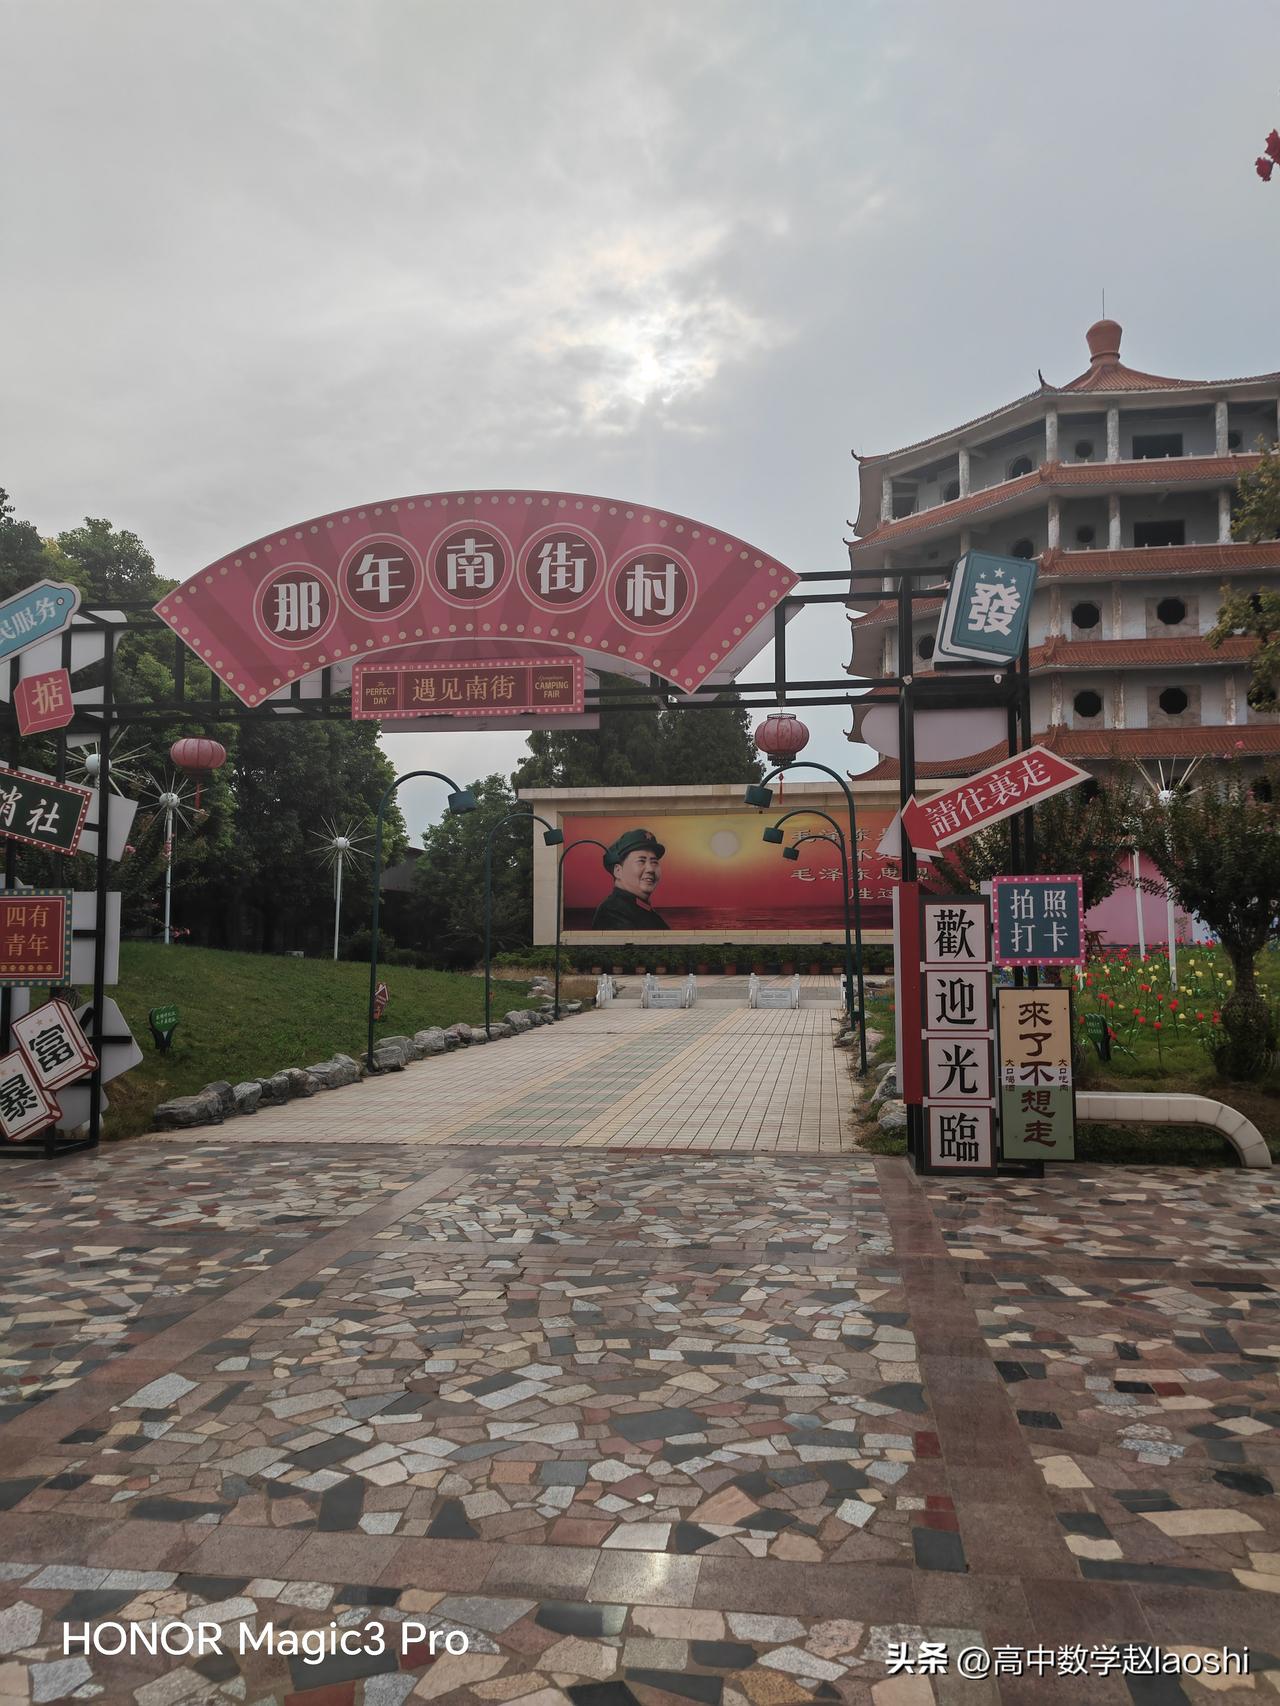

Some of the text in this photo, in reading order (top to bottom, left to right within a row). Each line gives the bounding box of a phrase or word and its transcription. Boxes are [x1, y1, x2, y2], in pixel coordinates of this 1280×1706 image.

[273, 537, 679, 634] 那年南街村
[967, 582, 1021, 636] 發
[31, 677, 64, 714] 掂
[365, 687, 396, 697] PERFECT
[412, 675, 516, 702] 遇见南街
[535, 680, 569, 690] CAMPING
[543, 690, 560, 699] FAIR
[373, 697, 388, 705] DAY
[925, 758, 1051, 838] 請往裏走
[6, 905, 49, 928] 四有
[1009, 889, 1068, 920] 拍照
[5, 933, 49, 957] 青年
[1010, 922, 1069, 953] 打卡
[28, 1024, 75, 1073] 富
[933, 909, 980, 1163] 歡迎光臨
[1018, 1000, 1057, 1148] 來了不想走
